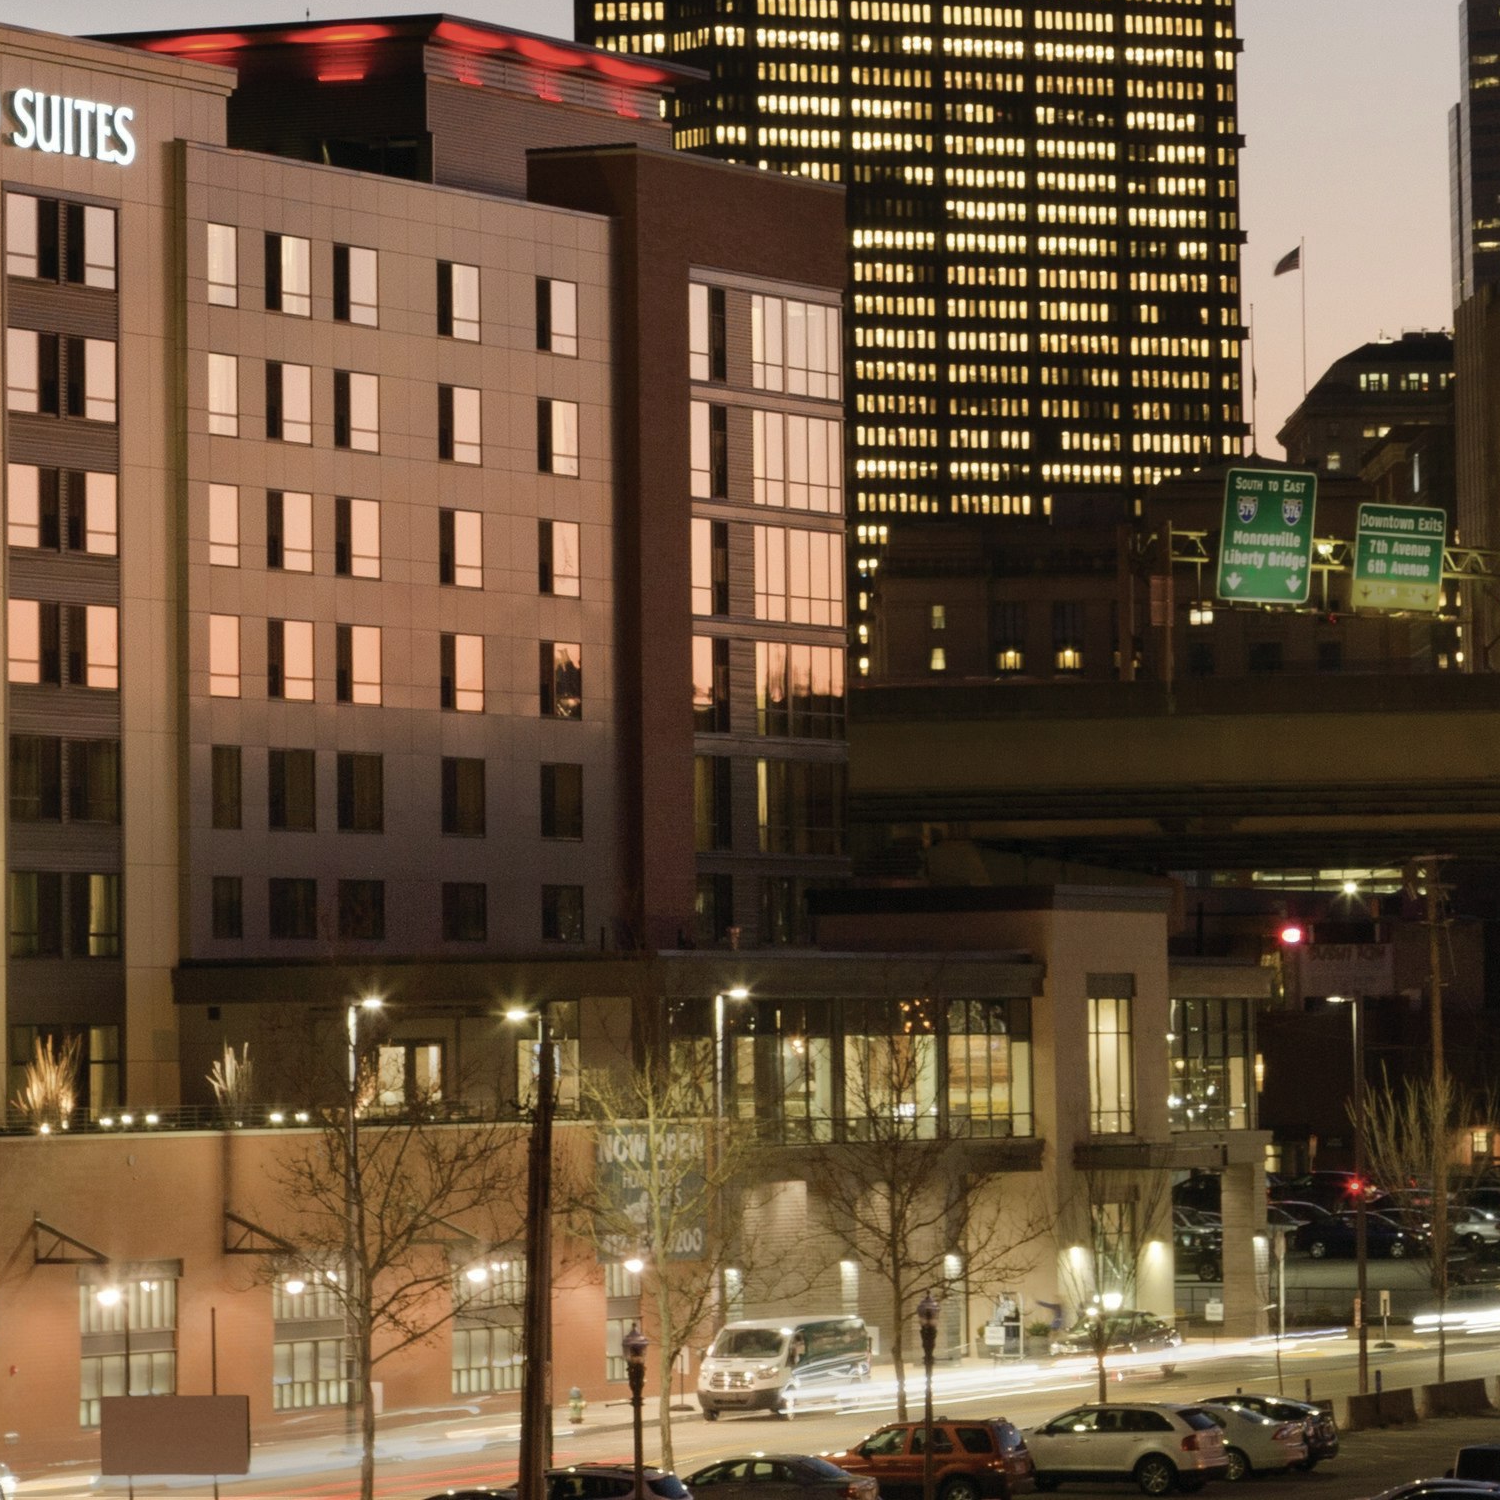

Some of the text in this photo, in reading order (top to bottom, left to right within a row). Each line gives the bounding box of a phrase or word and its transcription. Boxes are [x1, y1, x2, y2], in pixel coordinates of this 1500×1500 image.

[12, 87, 136, 166] SUITES
[1235, 476, 1306, 493] SOUTH TO EAST
[1239, 503, 1300, 518] 579 376
[1361, 513, 1443, 533] Downtown Exits
[1233, 530, 1301, 548] Monroeville
[1369, 539, 1431, 557] 7th Avenue
[1224, 549, 1307, 571] Liberty Bridge
[1367, 559, 1430, 577] 6th Avenue
[598, 1133, 648, 1163] NOW
